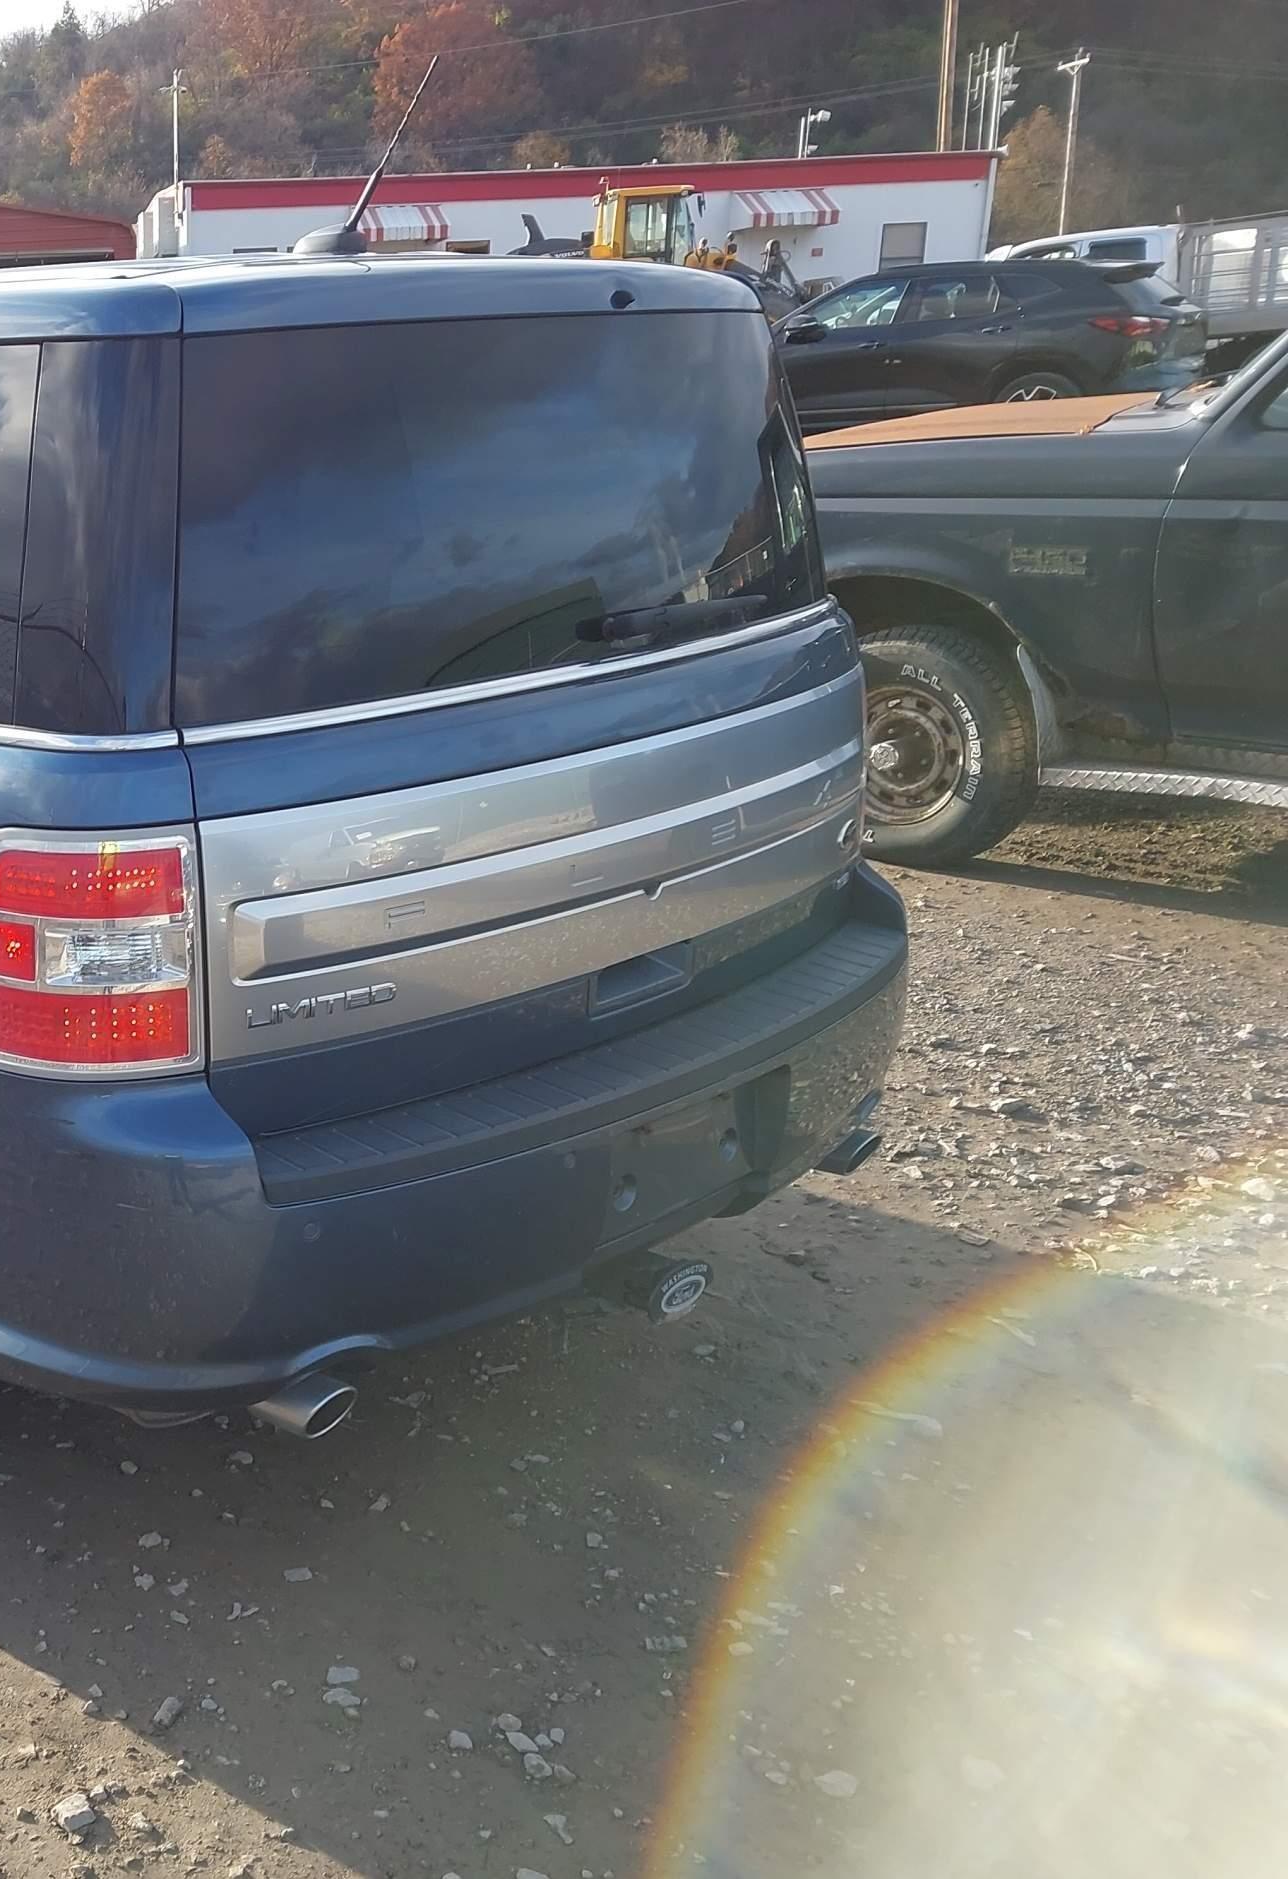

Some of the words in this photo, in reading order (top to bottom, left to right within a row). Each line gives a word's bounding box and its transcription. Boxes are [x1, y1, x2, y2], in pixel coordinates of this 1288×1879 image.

[901, 664, 942, 692] ALL
[952, 692, 982, 800] TERRAIN
[246, 982, 398, 1029] LIMITED
